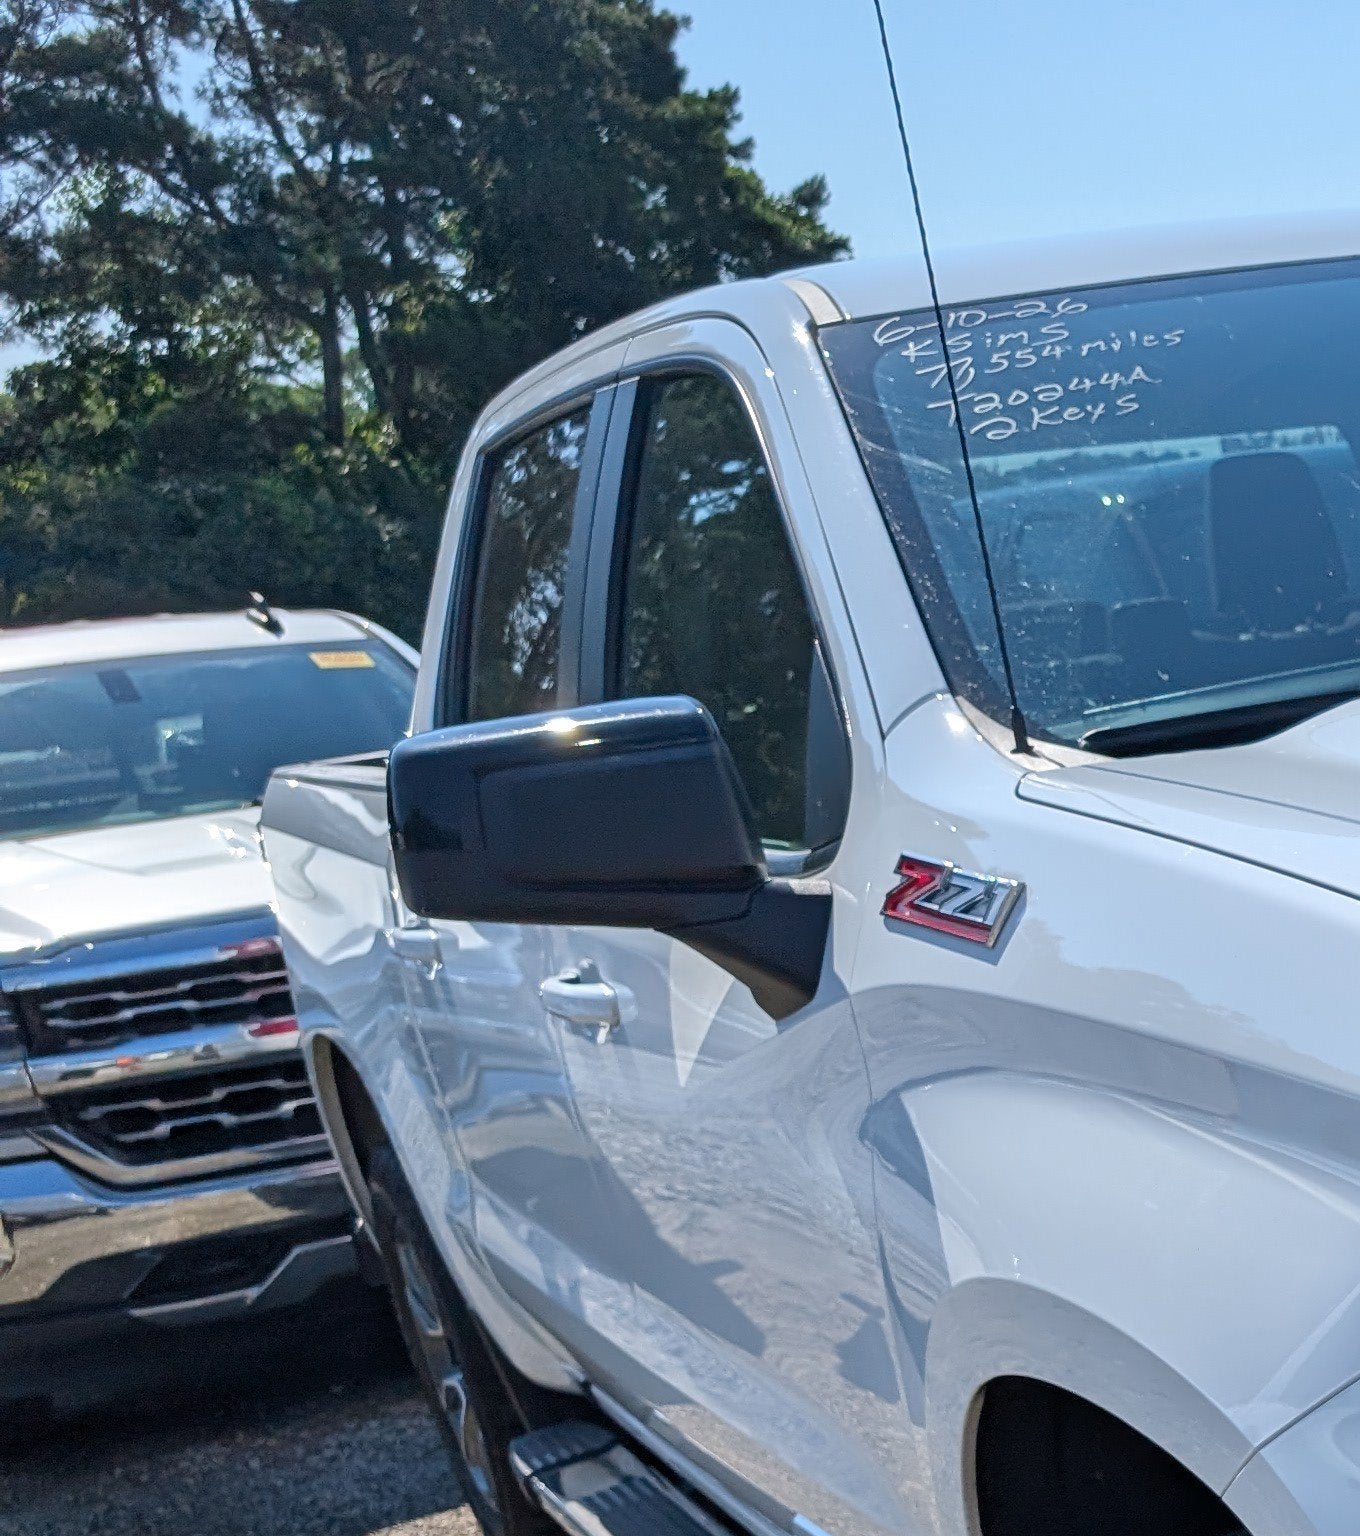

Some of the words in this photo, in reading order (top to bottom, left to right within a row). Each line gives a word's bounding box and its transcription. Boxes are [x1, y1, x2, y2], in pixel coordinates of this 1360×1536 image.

[873, 298, 1089, 347] 6-10-26
[1081, 329, 1185, 357] miles
[969, 415, 1018, 441] 2
